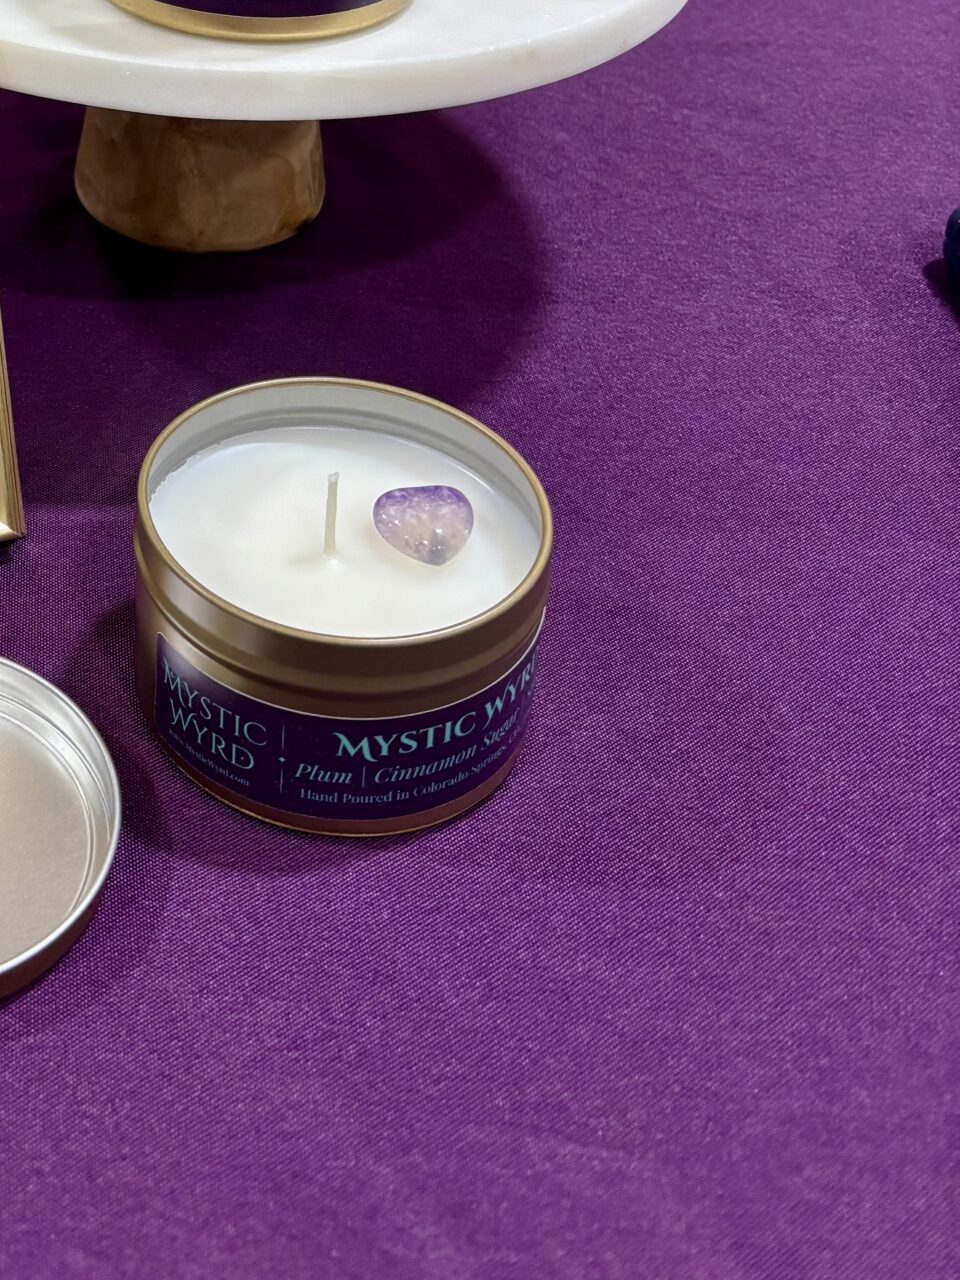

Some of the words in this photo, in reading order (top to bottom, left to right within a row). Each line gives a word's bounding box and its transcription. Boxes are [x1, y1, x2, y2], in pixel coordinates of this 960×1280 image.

[163, 655, 268, 747] MYSTIC
[169, 696, 256, 771] WYRD
[334, 709, 477, 763] MYSTIC
[293, 763, 354, 786] Plum
[373, 743, 478, 785] Cinnamon
[480, 706, 521, 752] Sugar
[299, 787, 339, 804] Hand
[342, 788, 394, 805] Poured
[395, 787, 410, 801] in
[413, 769, 470, 798] Colorado
